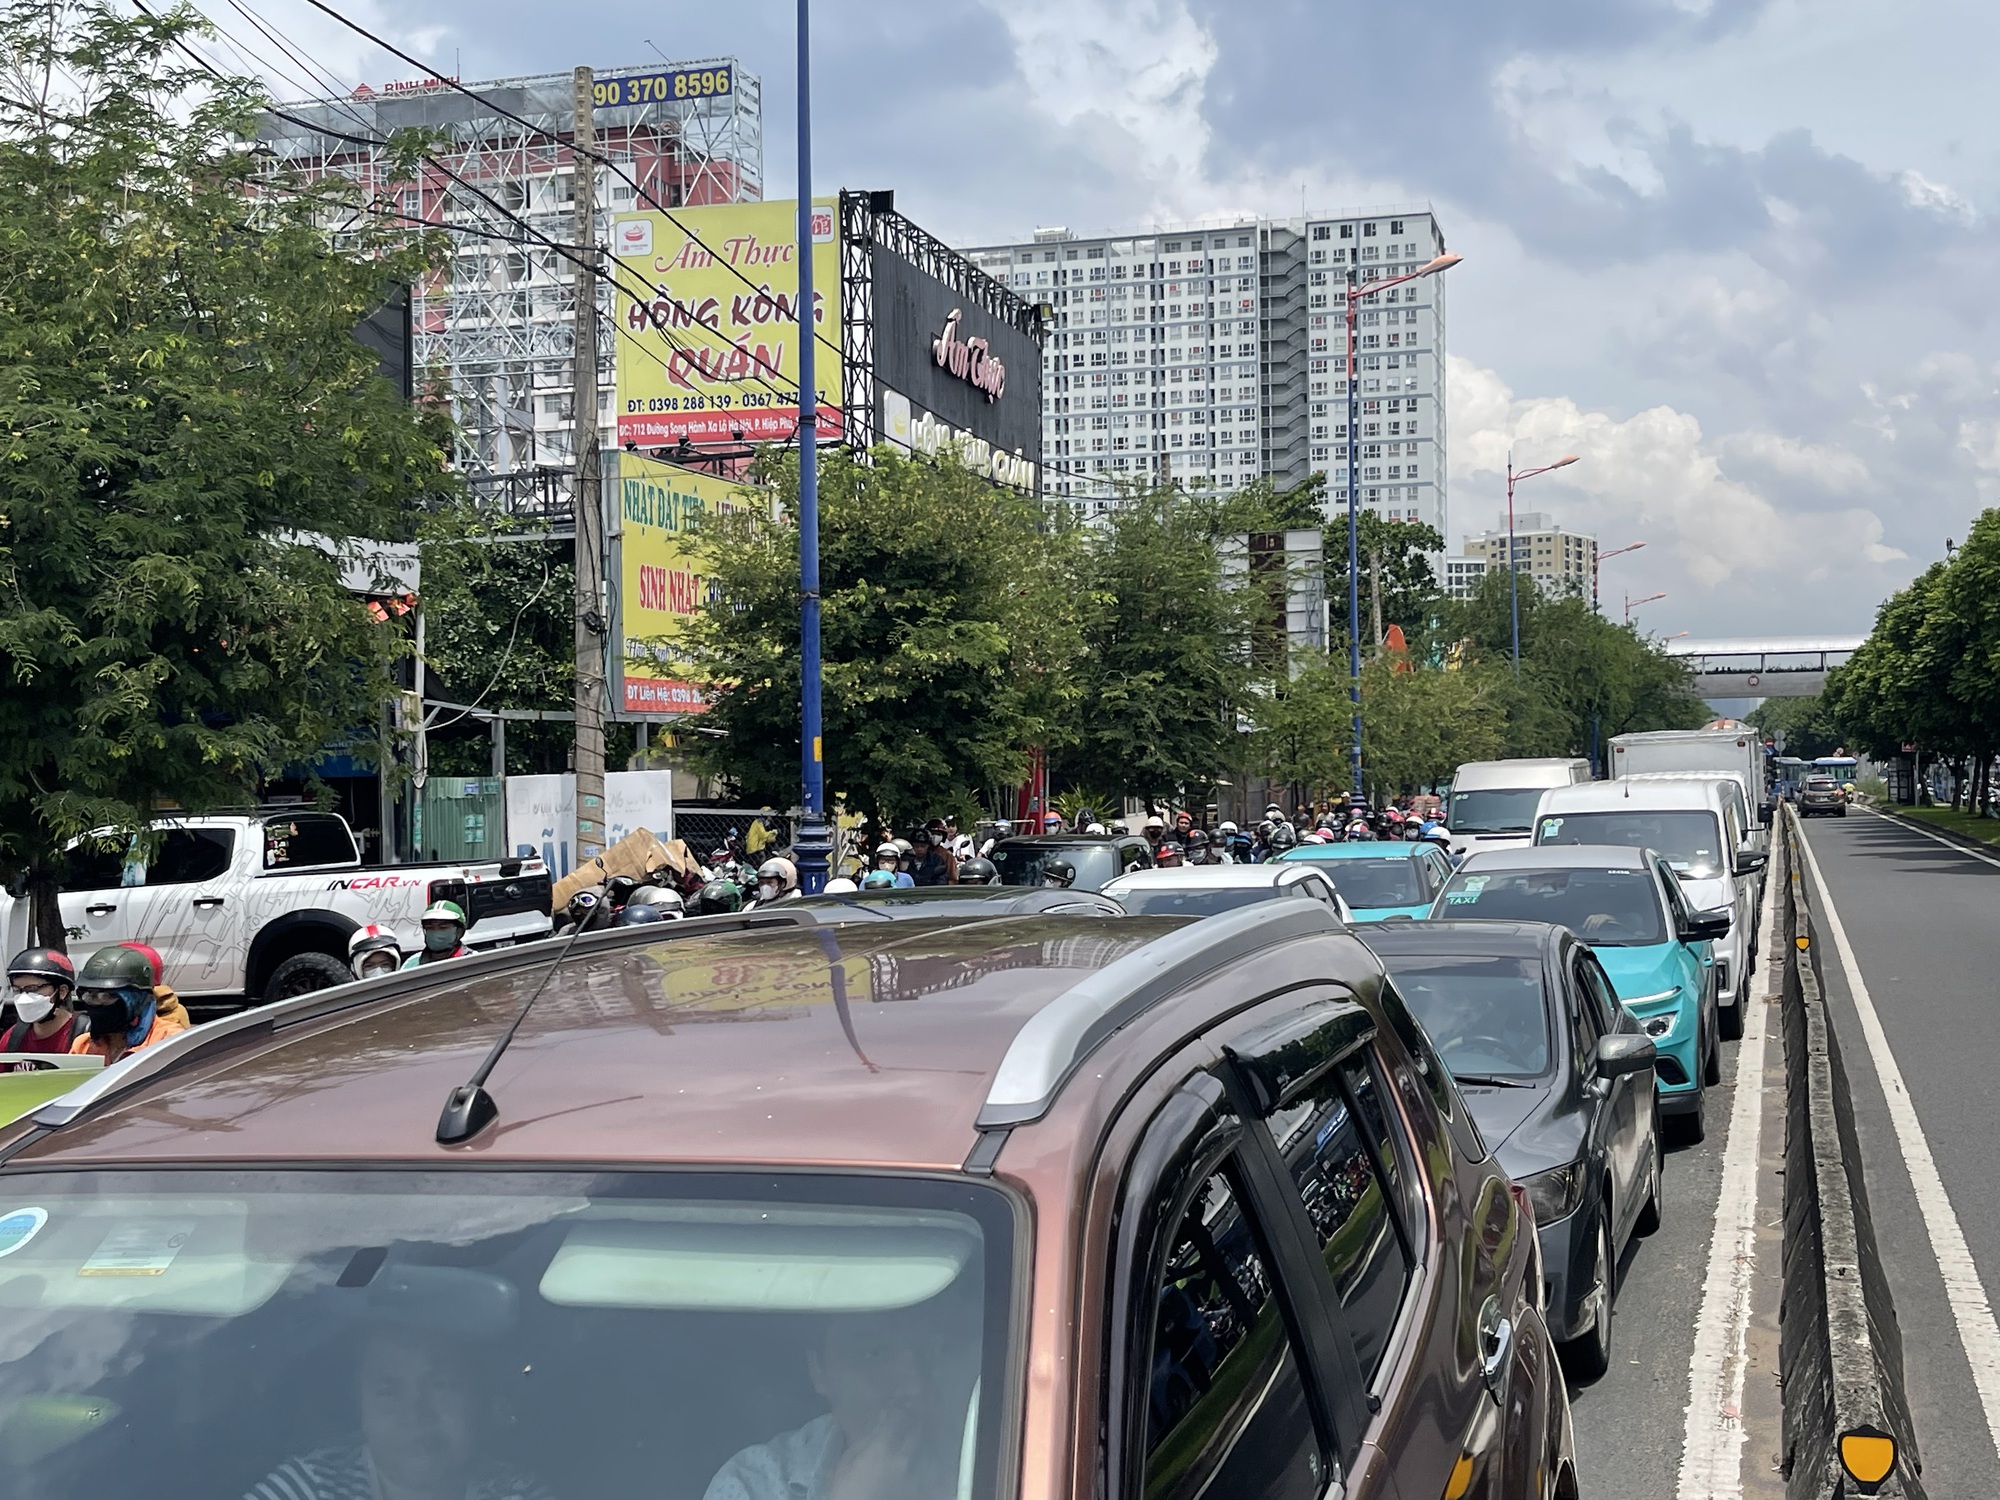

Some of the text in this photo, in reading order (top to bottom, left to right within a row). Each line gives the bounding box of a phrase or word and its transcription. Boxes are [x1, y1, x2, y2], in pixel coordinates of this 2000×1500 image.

[627, 77, 668, 103] 370
[674, 70, 729, 98] 8596
[654, 228, 794, 272] Ẩm Thực
[627, 284, 719, 332] HỒNG
[667, 332, 783, 390] QUÁN
[649, 398, 679, 411] 0398
[682, 396, 705, 409] 288
[709, 394, 731, 408] 139
[742, 393, 772, 407] 0367
[633, 423, 645, 436] 712
[624, 471, 655, 536] NHẬT
[639, 563, 667, 612] SINH
[1450, 897, 1477, 905] TAXI
